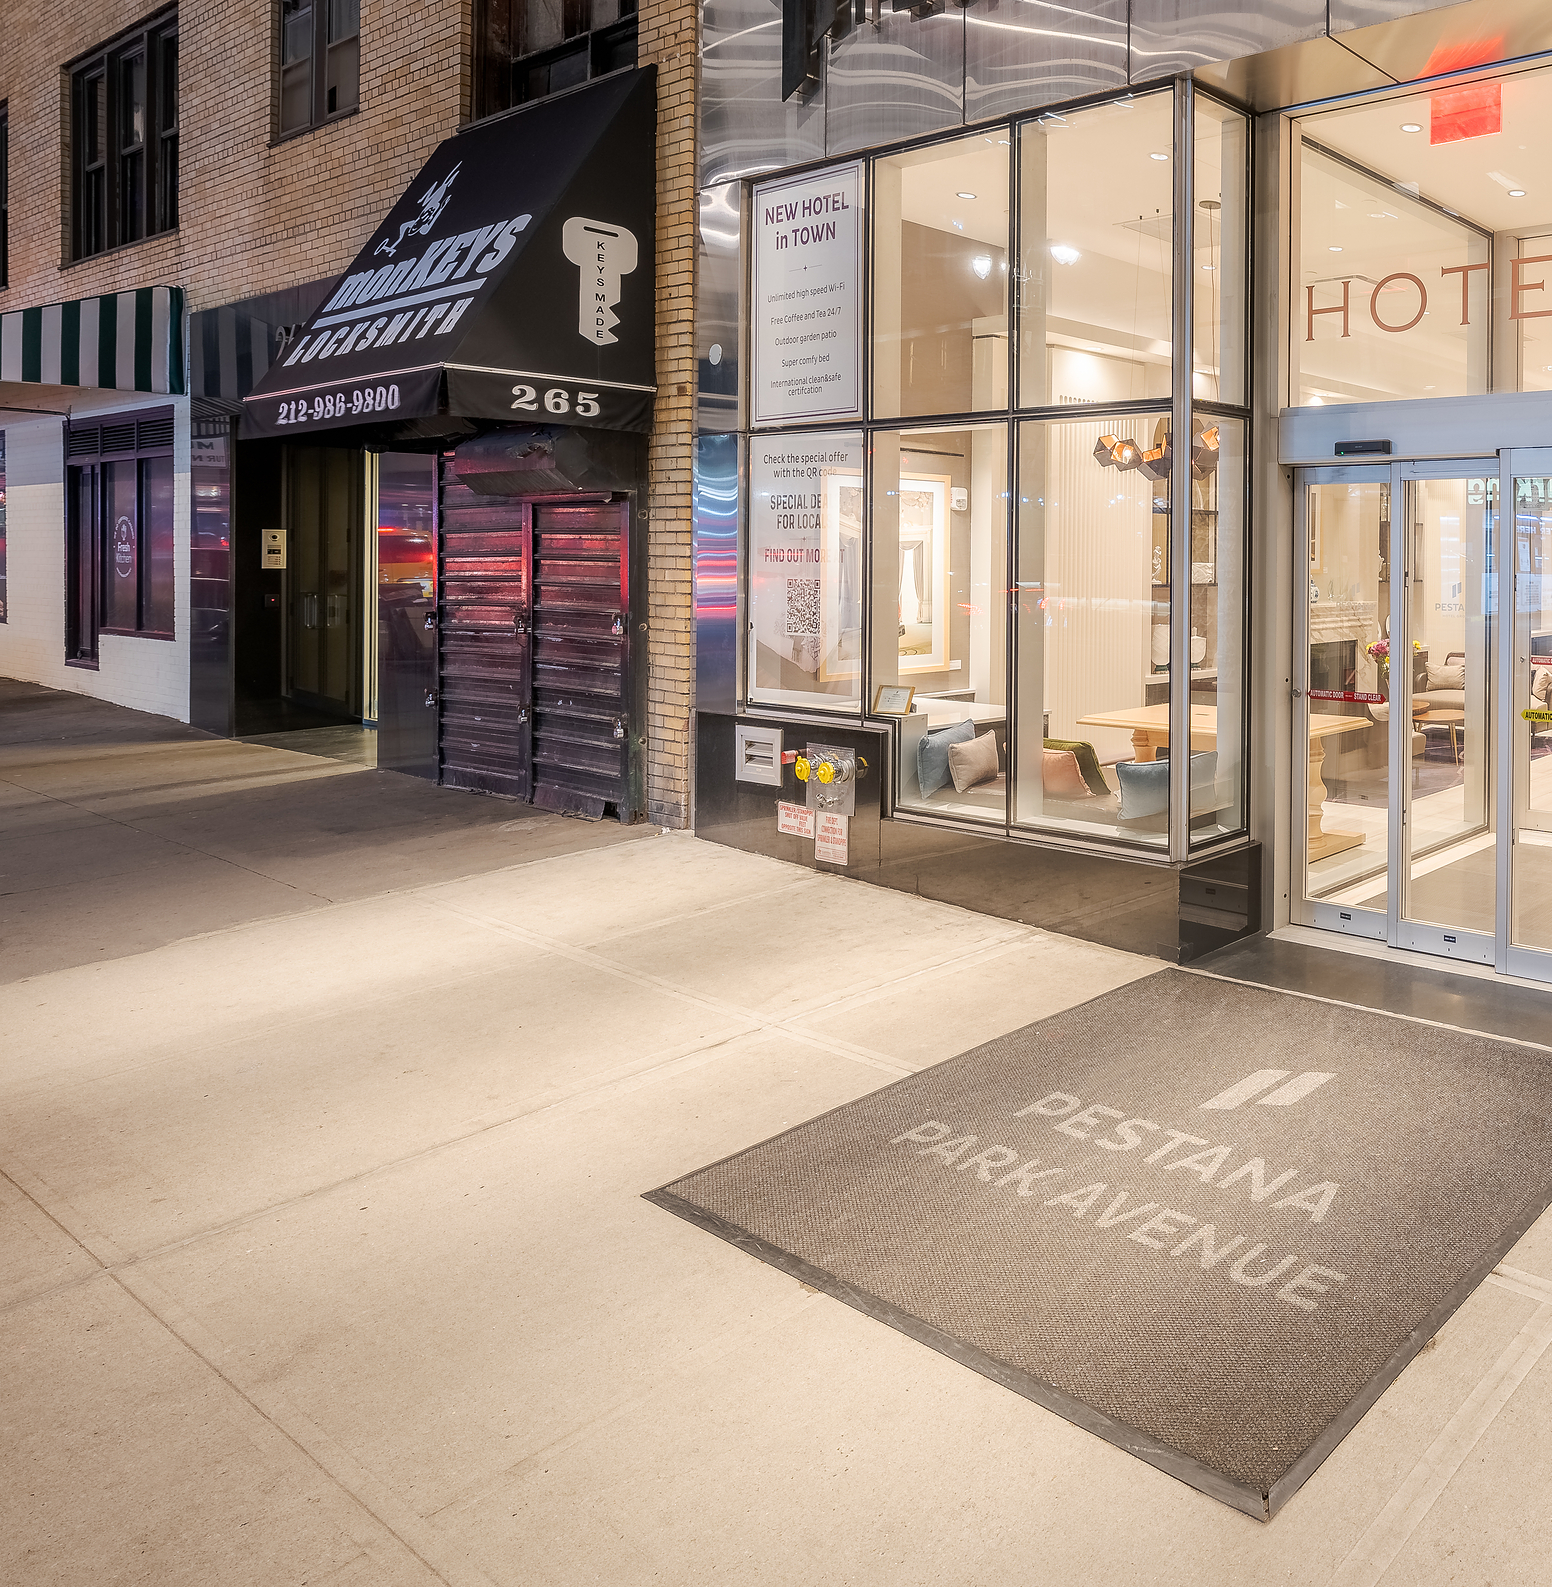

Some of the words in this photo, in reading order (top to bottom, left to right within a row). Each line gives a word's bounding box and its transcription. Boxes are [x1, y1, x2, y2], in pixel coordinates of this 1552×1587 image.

[765, 201, 798, 225] NEW
[802, 191, 849, 218] HOTEL
[776, 231, 788, 250] in
[792, 221, 836, 247] TOWN
[596, 241, 605, 287] KEYS
[767, 291, 796, 303] Unlimited
[796, 288, 810, 299] high
[810, 285, 828, 297] speed
[828, 281, 846, 292] Wi-Fi
[595, 293, 606, 338] MADE
[770, 317, 784, 325] Free
[784, 313, 804, 324] Coffee
[804, 311, 816, 320] and
[816, 309, 827, 318] Tea
[827, 306, 842, 317] 24/7
[282, 297, 475, 368] LOCKSMITH
[775, 336, 799, 346] Outdoor
[800, 332, 821, 344] garden
[821, 330, 838, 341] patio
[781, 358, 799, 368] Super
[799, 354, 818, 365] comfy
[818, 353, 830, 363] bed
[770, 376, 808, 388] International
[808, 372, 842, 384] clean&safe
[275, 384, 401, 426] 212-986-9800
[510, 385, 602, 418] 265
[763, 453, 786, 465] Check
[787, 453, 800, 463] the
[801, 452, 828, 465] special
[828, 451, 849, 462] offer
[773, 467, 791, 478] with
[792, 467, 805, 477] the
[806, 467, 818, 479] QR
[818, 466, 838, 477] code
[770, 494, 808, 510] SPECIAL
[777, 514, 795, 530] FOR
[764, 548, 785, 562] FIND
[786, 548, 804, 562] OUT
[1310, 689, 1333, 698] AUTOMATIC
[1333, 691, 1344, 699] DOOR
[1353, 692, 1367, 701] STAND
[1367, 694, 1381, 702] CLEAR
[1525, 711, 1552, 721] AUTOMATIC
[1013, 1091, 1341, 1224] PESTANA
[890, 1119, 1067, 1198] PARK
[1043, 1181, 1347, 1312] AVENUE
